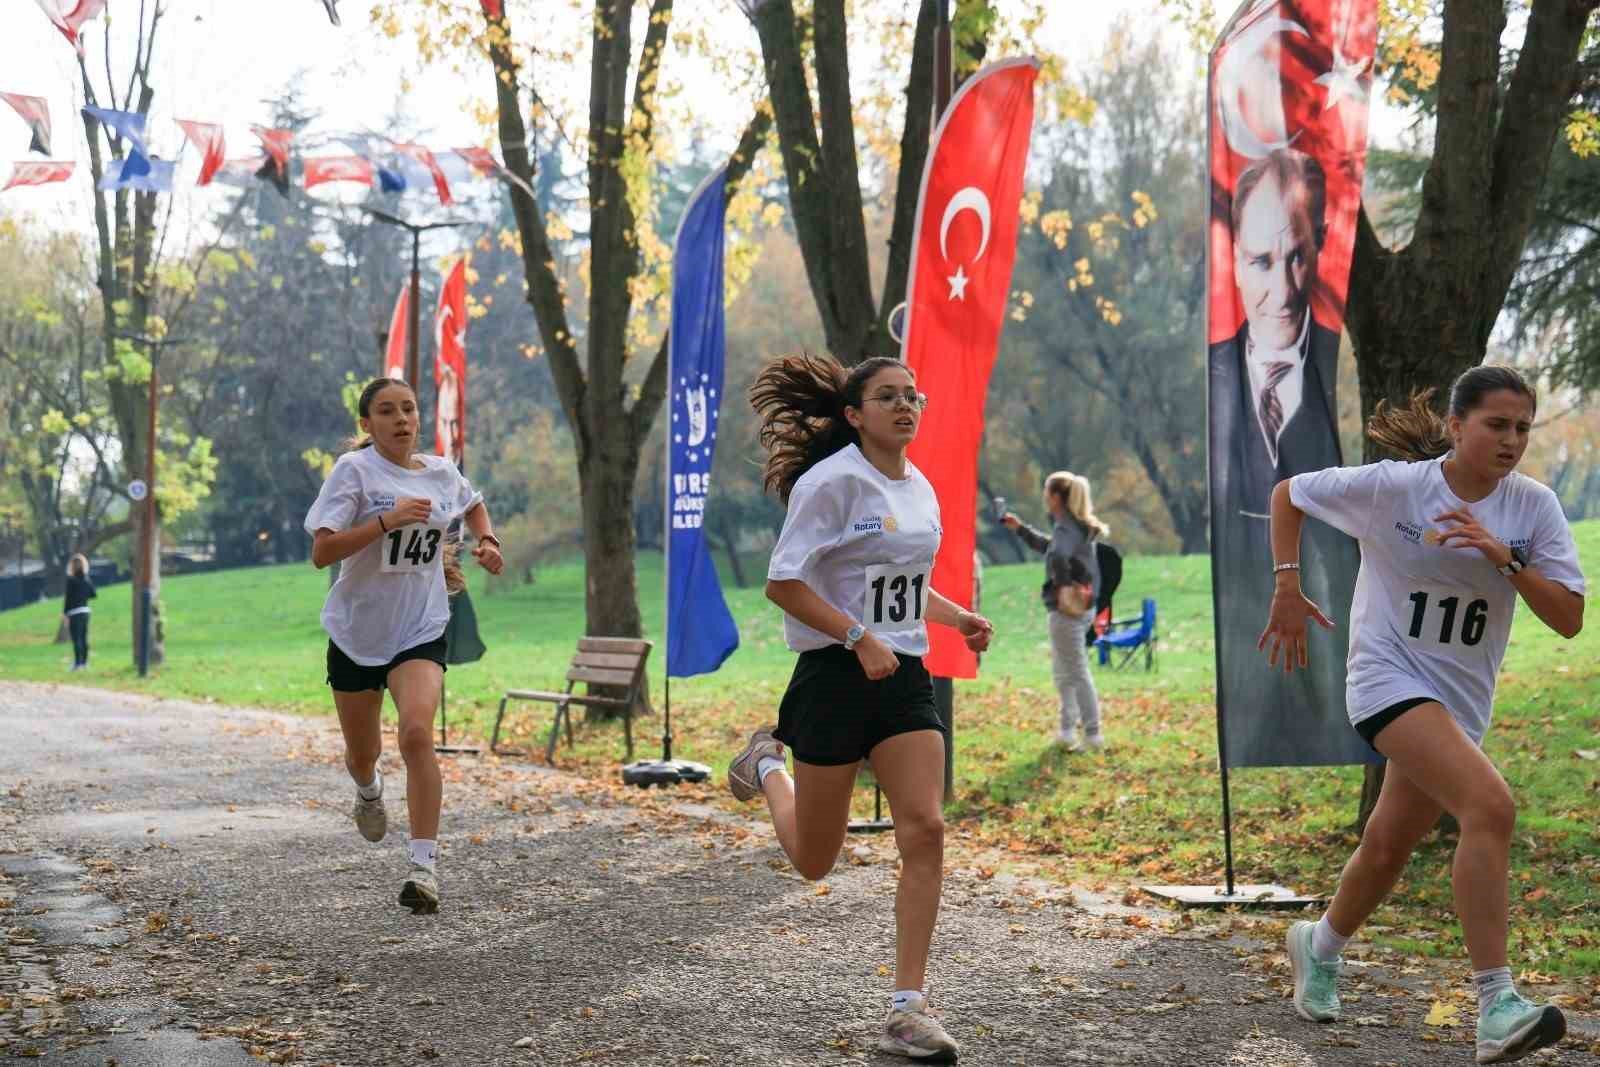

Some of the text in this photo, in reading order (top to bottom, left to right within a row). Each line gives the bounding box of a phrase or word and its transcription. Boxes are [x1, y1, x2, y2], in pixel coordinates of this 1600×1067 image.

[854, 523, 882, 532] Rotary
[1395, 522, 1422, 539] Rotary
[388, 528, 442, 567] 143
[871, 573, 925, 624] 131
[1408, 591, 1489, 647] 116
